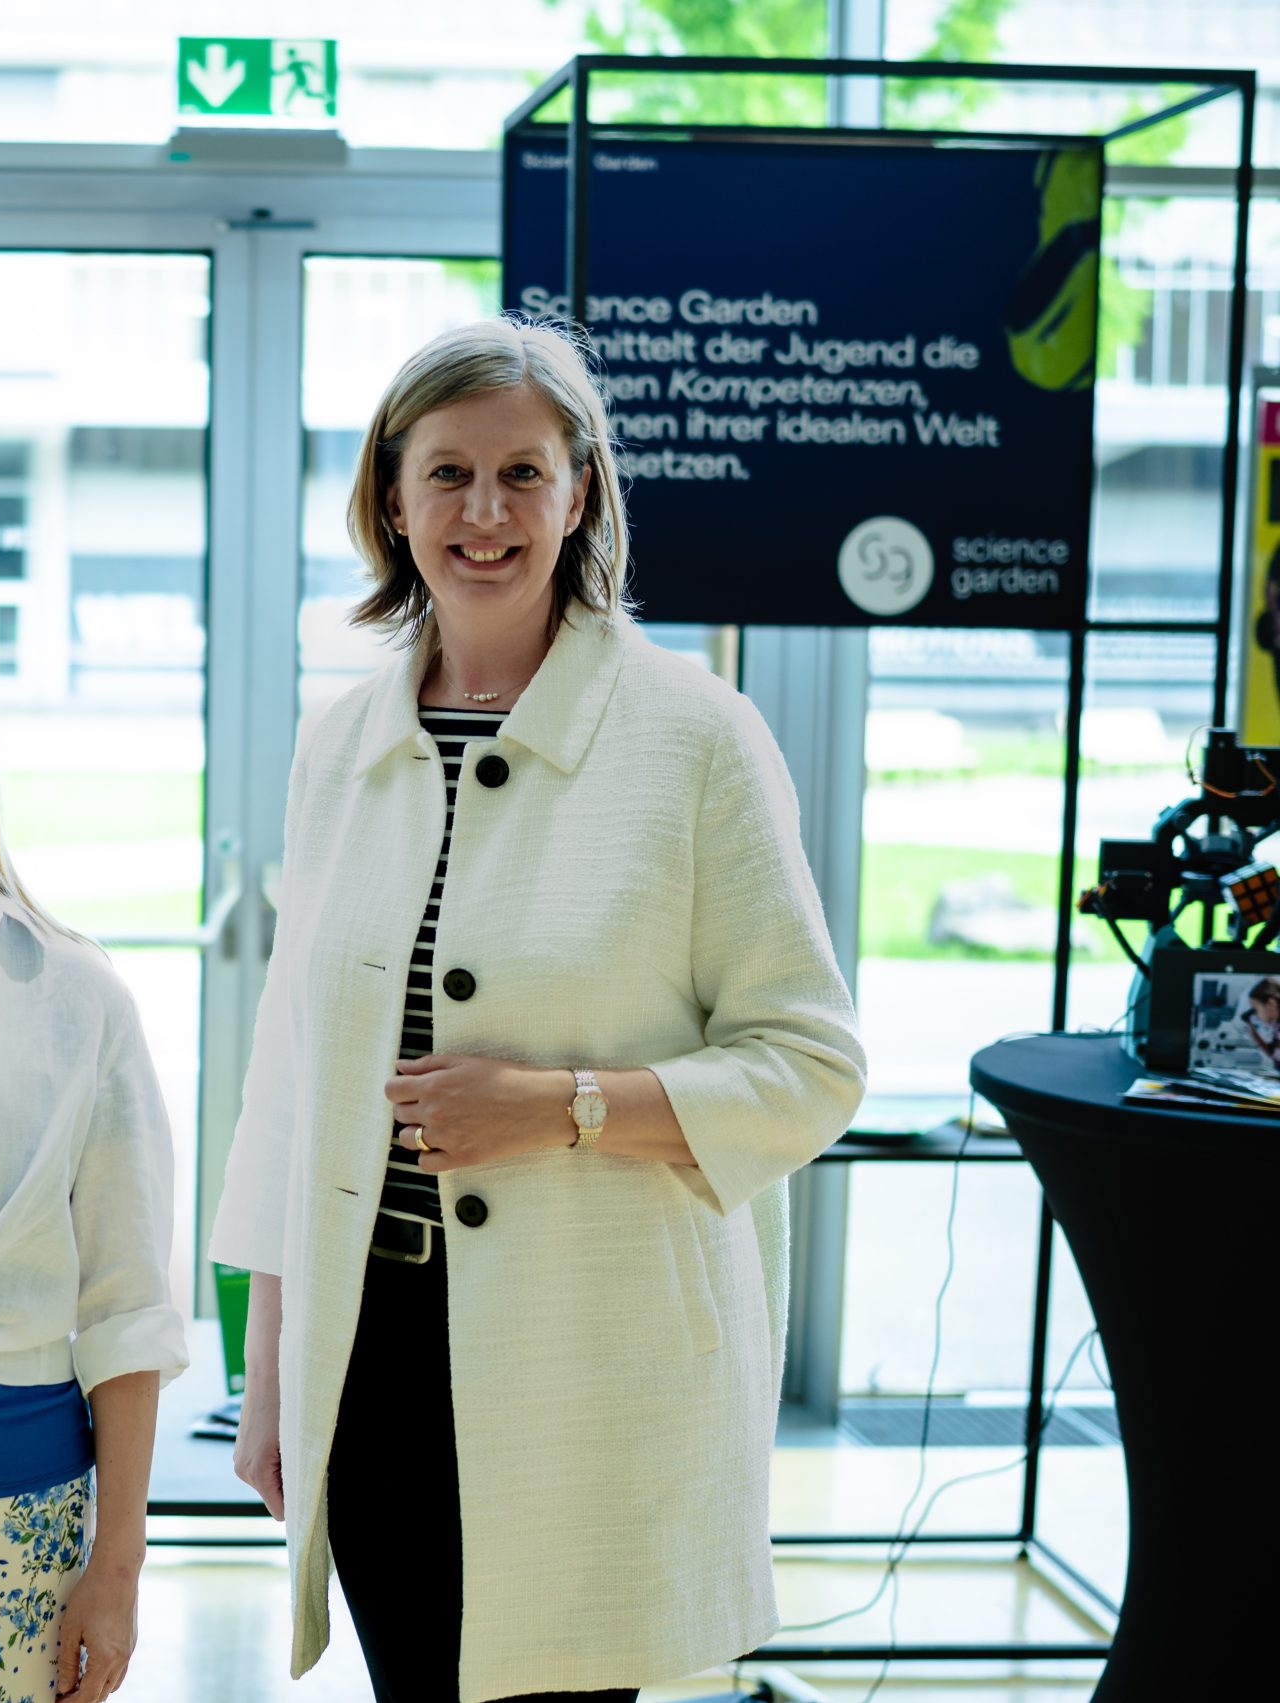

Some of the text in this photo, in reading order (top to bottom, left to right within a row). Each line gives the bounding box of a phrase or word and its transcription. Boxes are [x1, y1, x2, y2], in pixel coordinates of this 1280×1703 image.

[678, 289, 819, 326] Garden
[703, 330, 770, 364] der
[774, 332, 917, 374] Jugend
[922, 334, 980, 369] die
[668, 368, 928, 411] Kompetenzen,
[686, 407, 770, 442] ihrer
[776, 408, 907, 445] idealen
[913, 411, 1001, 447] Welt
[951, 531, 1070, 564] science
[951, 566, 1060, 600] garden
